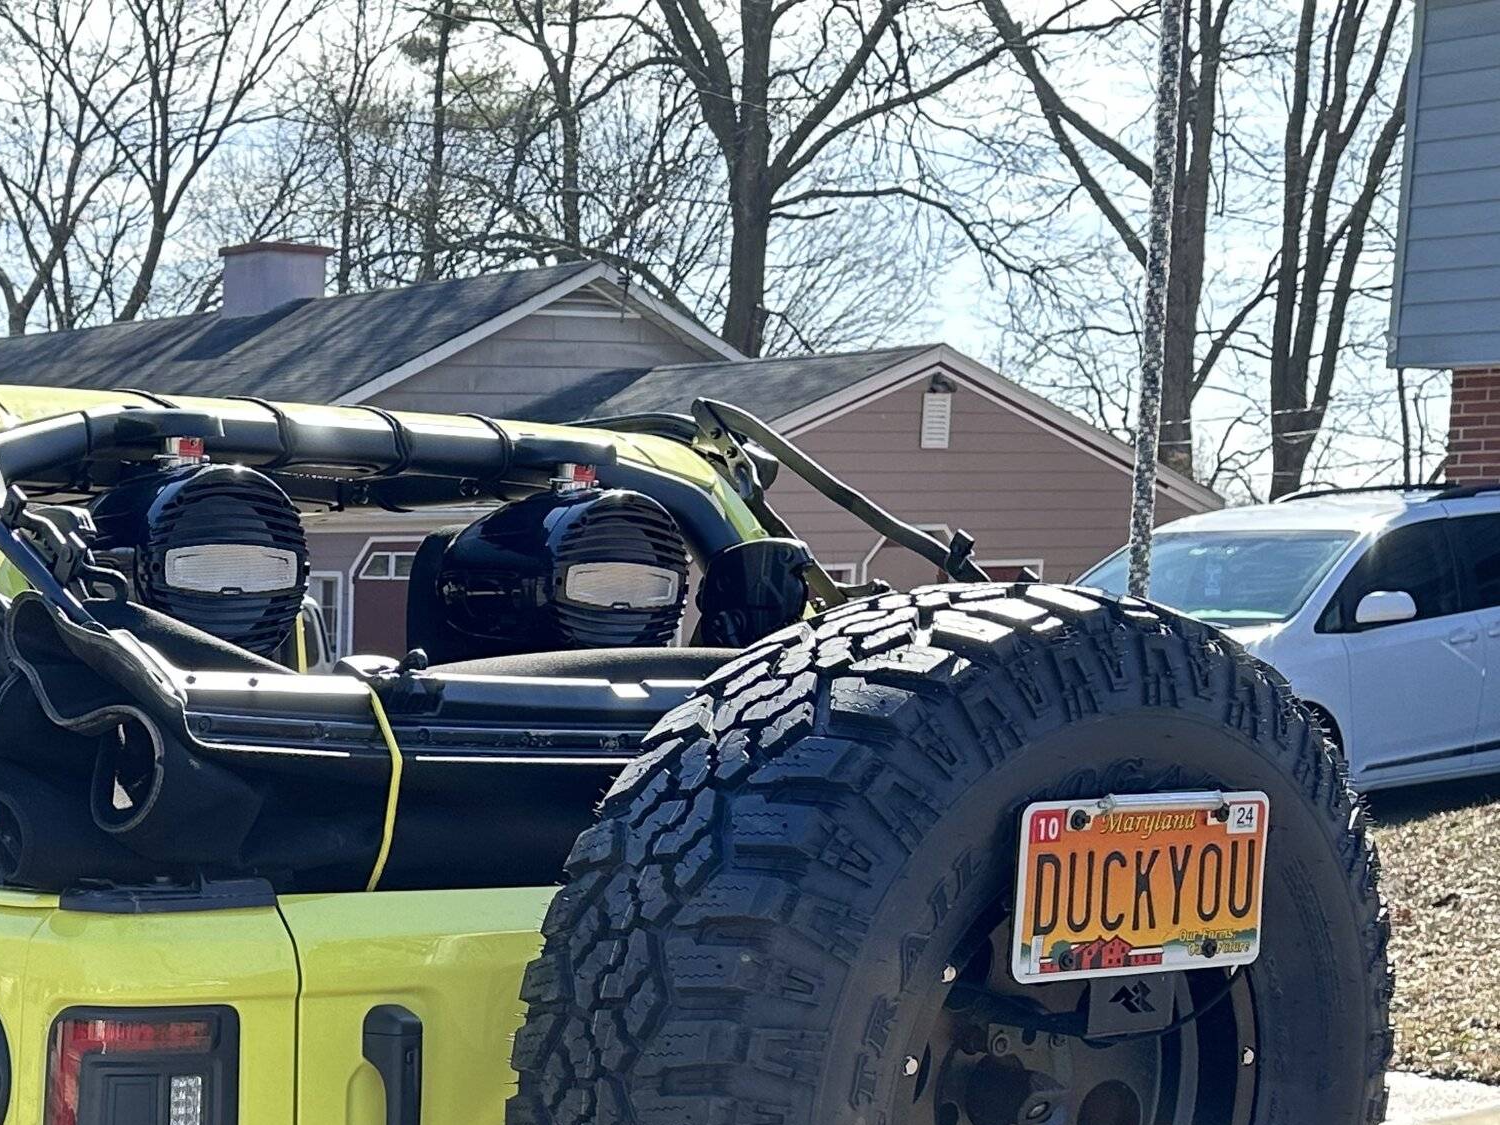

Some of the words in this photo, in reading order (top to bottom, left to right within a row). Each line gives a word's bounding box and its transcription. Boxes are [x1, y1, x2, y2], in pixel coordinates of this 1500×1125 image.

[1099, 809, 1196, 839] Maryland
[1236, 806, 1254, 825] 24
[1037, 817, 1059, 840] 10
[1033, 839, 1256, 937] DUCKYOU
[1179, 928, 1200, 943] Our
[1216, 940, 1251, 954] Future
